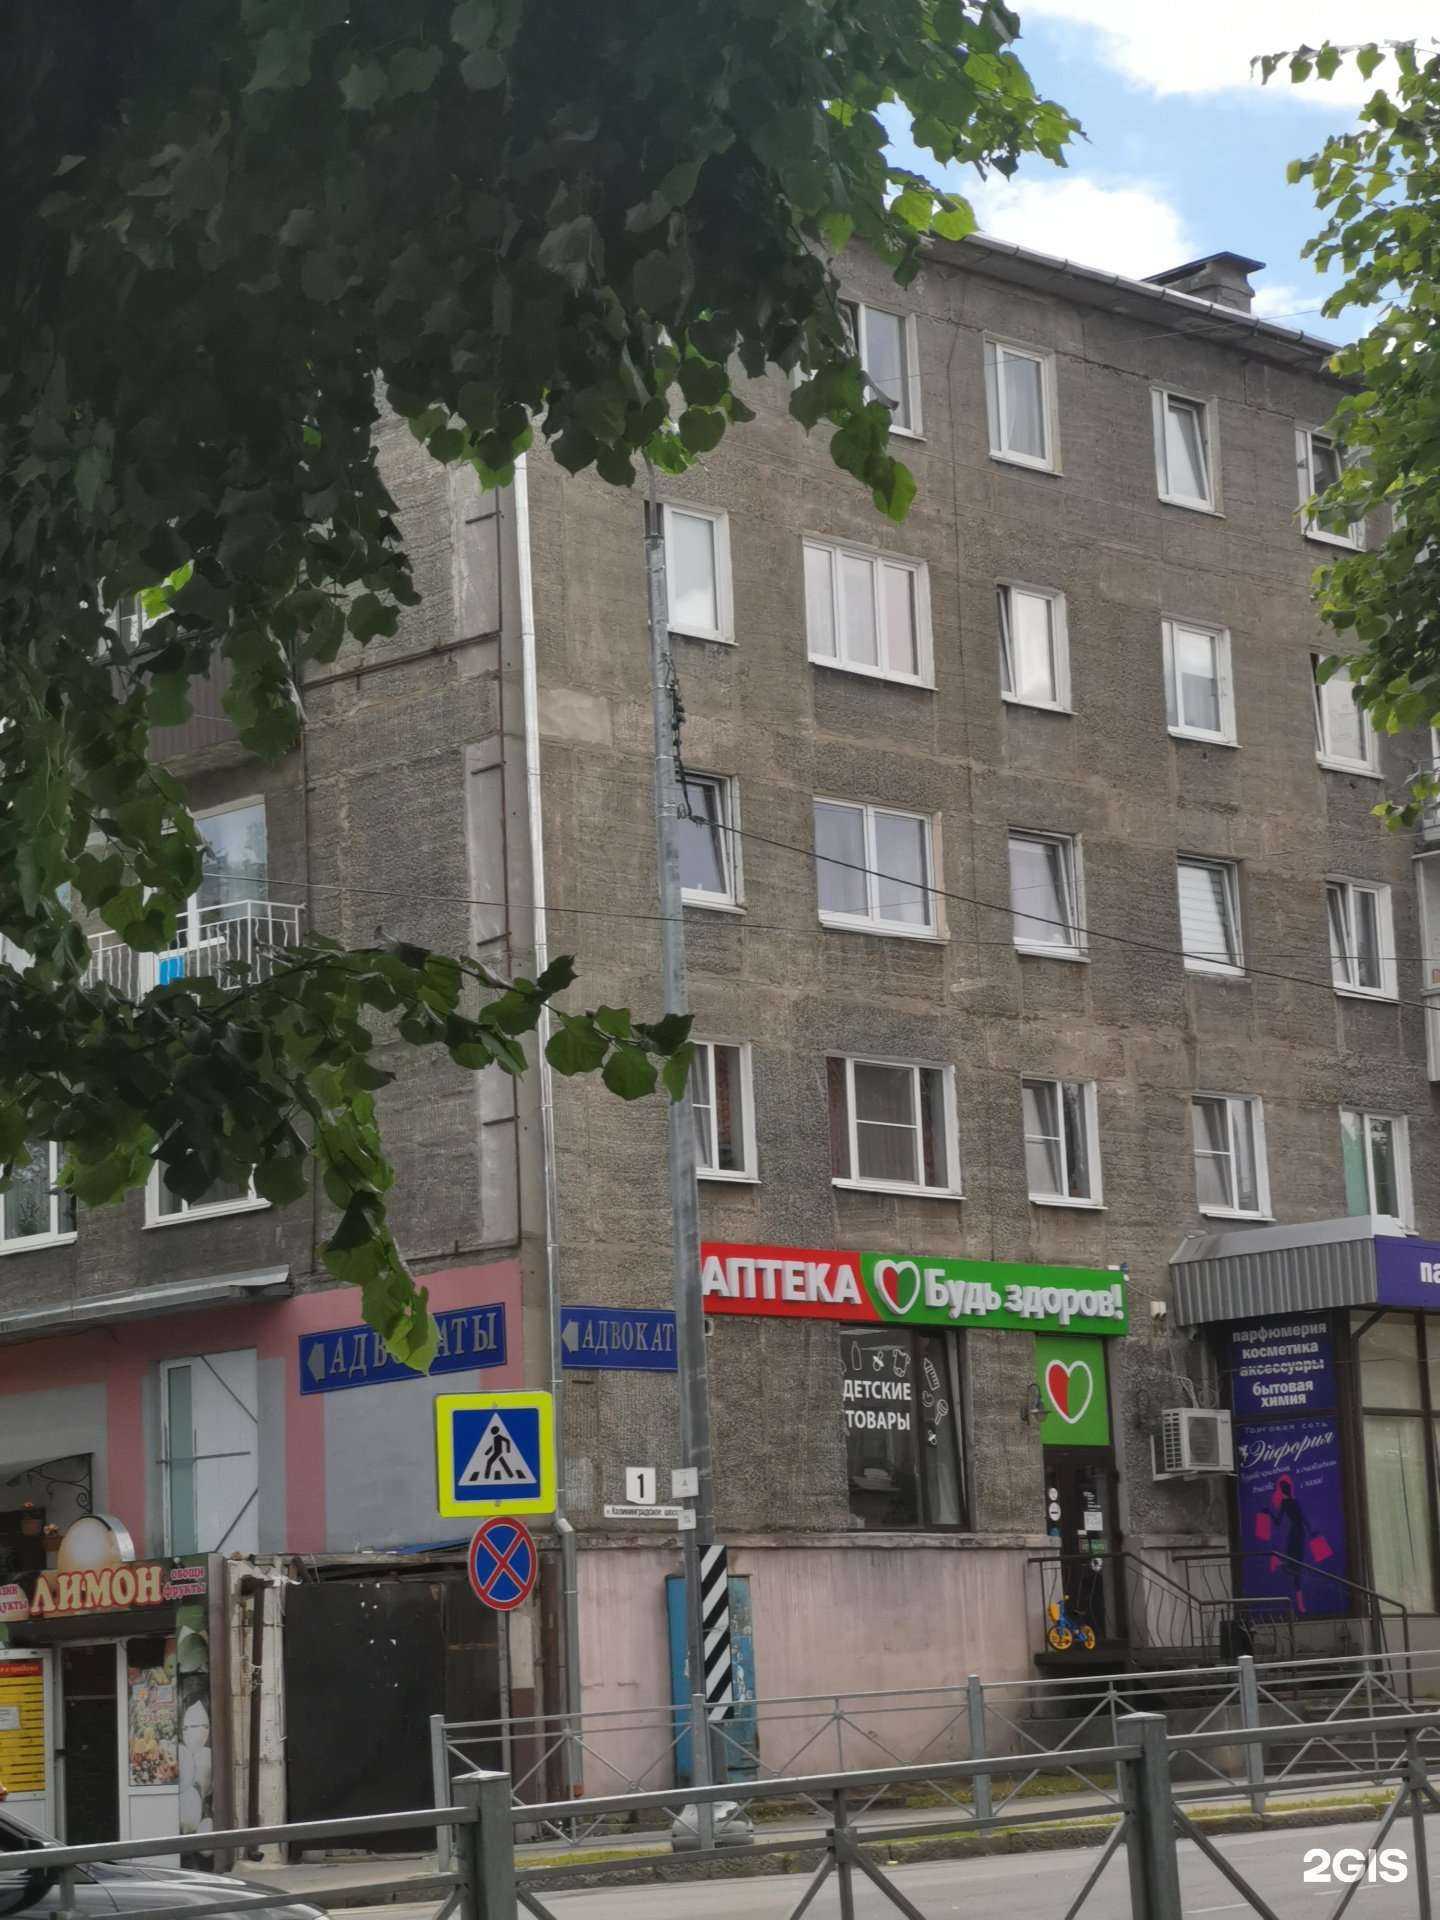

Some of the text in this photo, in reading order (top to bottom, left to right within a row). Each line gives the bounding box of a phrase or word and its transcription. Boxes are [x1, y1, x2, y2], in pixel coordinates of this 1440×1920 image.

[702, 1255, 1124, 1326] АПТЕКА Будь здоров!
[1232, 1323, 1327, 1343] парфюмерия
[329, 1312, 497, 1378] АДВАТЫ
[1242, 1342, 1319, 1359] косметика
[1240, 1359, 1325, 1376] аксессуары
[843, 1380, 912, 1402] ДЕТСКИЕ
[1252, 1380, 1314, 1396] бытовая
[1261, 1394, 1307, 1408] химия
[845, 1410, 910, 1431] ТОВАРЫ
[637, 1473, 645, 1499] 1
[31, 1566, 162, 1613] ЛИМОН
